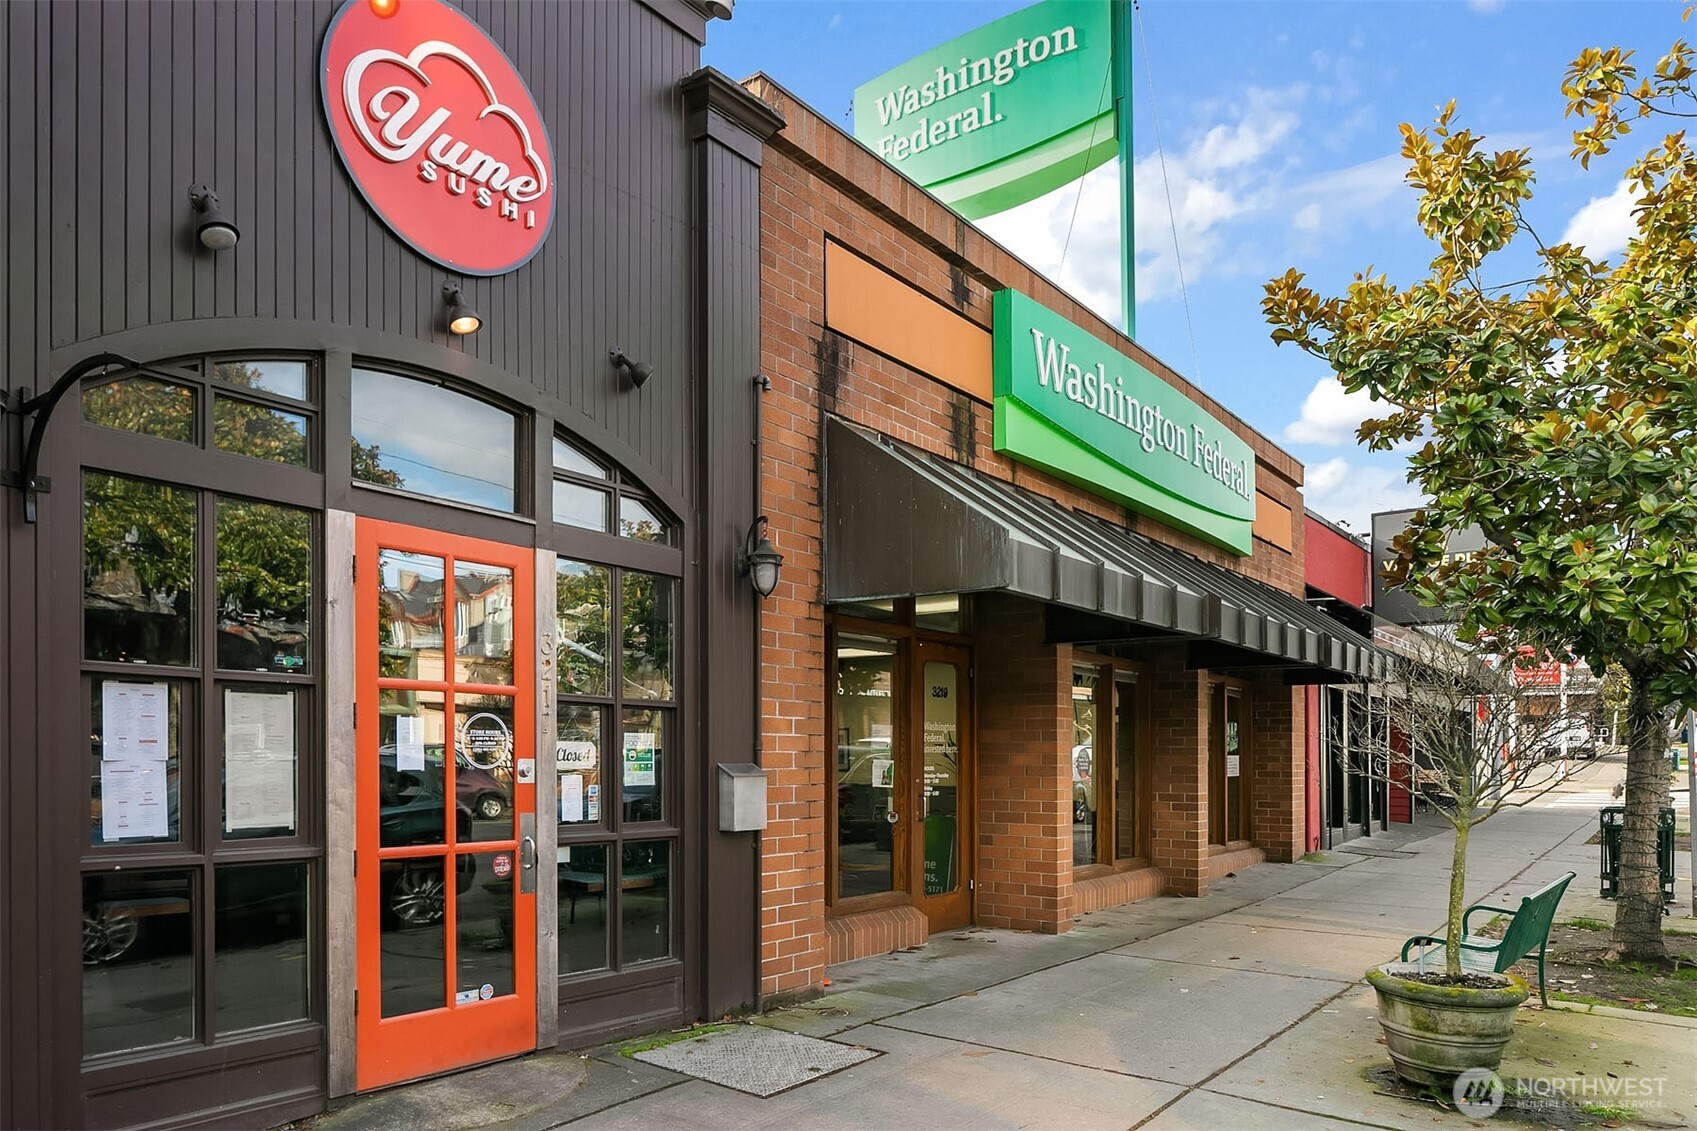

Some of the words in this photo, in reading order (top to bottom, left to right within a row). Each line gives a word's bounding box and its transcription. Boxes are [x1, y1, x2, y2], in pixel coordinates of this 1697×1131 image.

[875, 25, 1078, 126] Washington
[367, 85, 547, 203] Yume
[876, 91, 1004, 161] Federal.
[420, 159, 536, 229] SUSHI
[1030, 327, 1190, 454] Washington
[1190, 423, 1251, 502] Federal.
[924, 721, 955, 732] Washington
[932, 686, 948, 698] 3219
[556, 747, 591, 762] Closed
